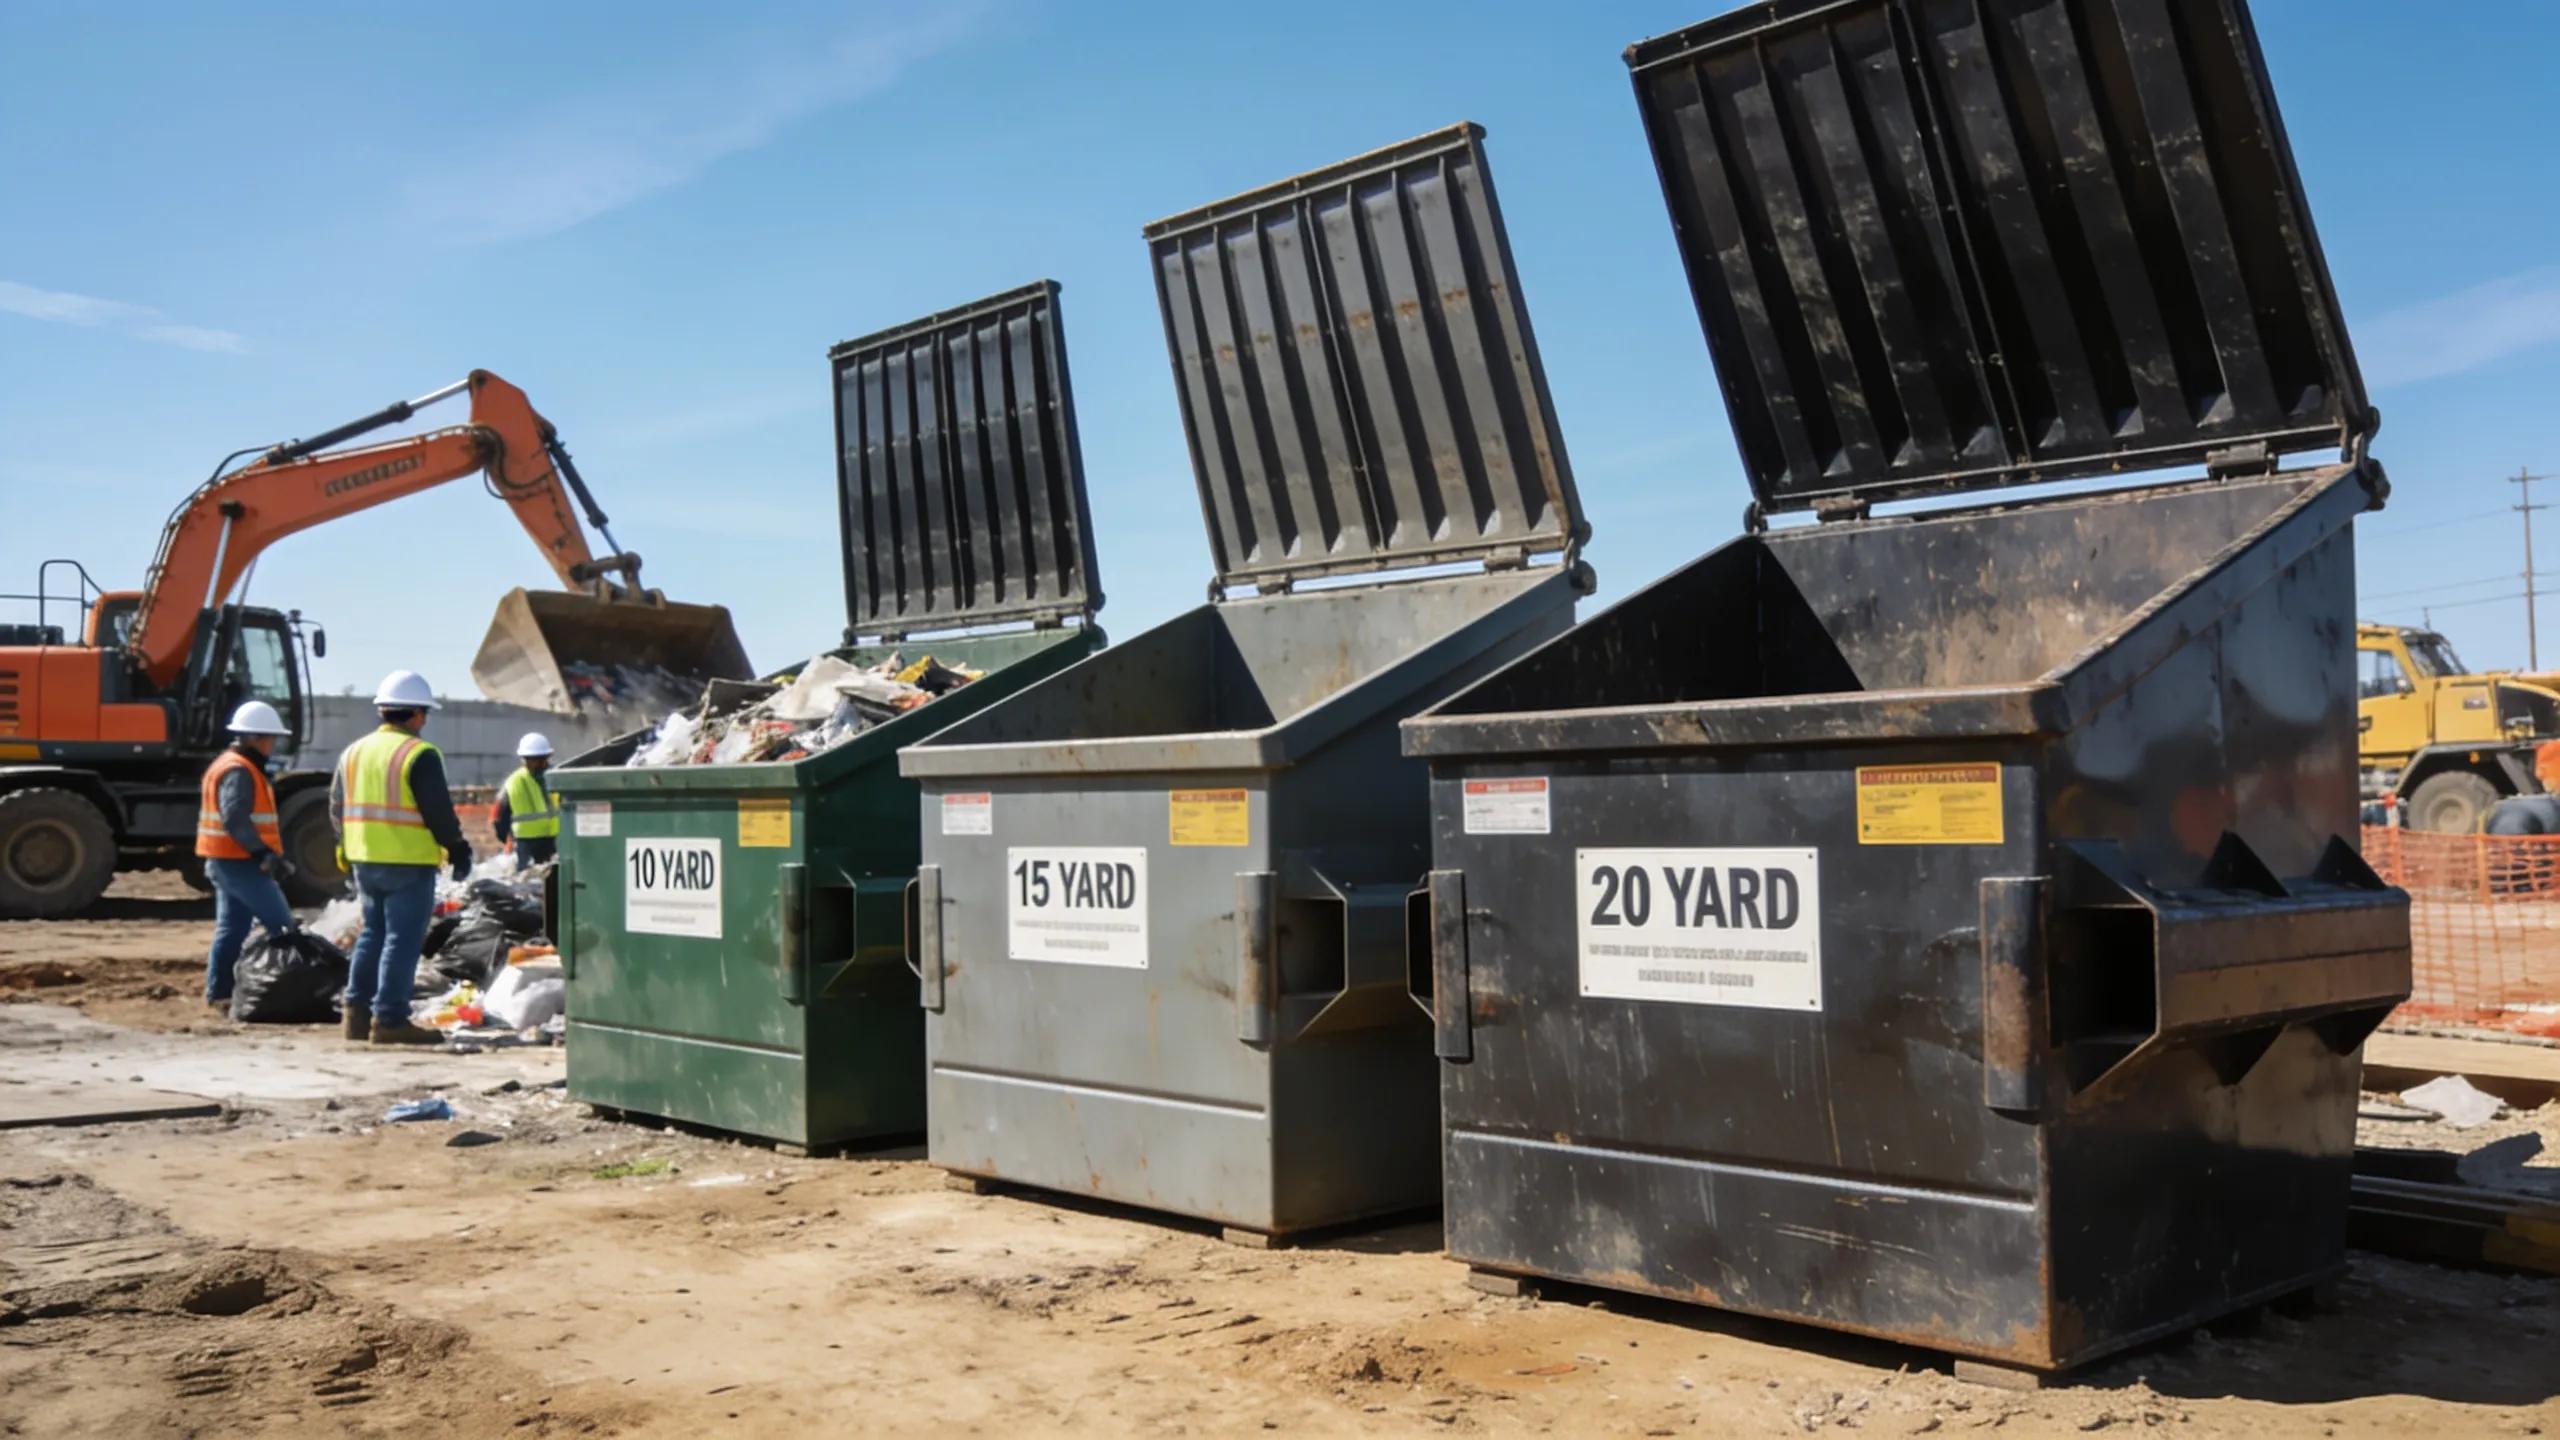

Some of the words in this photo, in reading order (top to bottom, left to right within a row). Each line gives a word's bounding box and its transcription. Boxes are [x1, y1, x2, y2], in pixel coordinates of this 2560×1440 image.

[628, 847, 656, 889] 10
[660, 850, 714, 890] YARD
[1014, 860, 1050, 908] 15
[1058, 862, 1135, 909] YARD
[1591, 865, 1651, 927] 20
[1663, 867, 1799, 930] YARD
